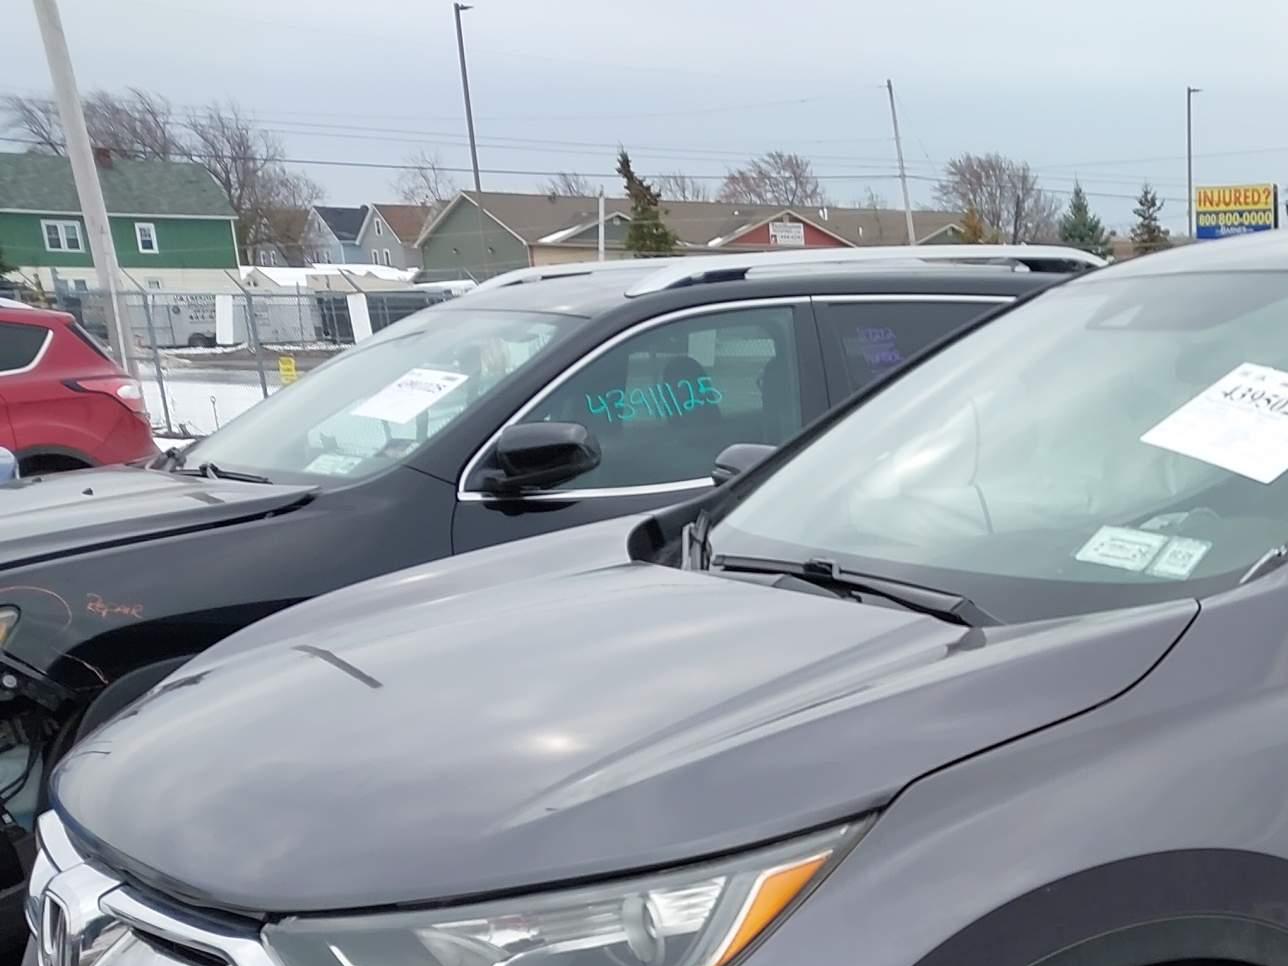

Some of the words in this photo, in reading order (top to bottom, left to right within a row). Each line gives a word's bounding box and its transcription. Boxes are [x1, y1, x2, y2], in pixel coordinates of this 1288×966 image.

[1198, 187, 1271, 207] INJURED?
[1218, 211, 1272, 225] 800-0000
[585, 377, 722, 422] 43911125
